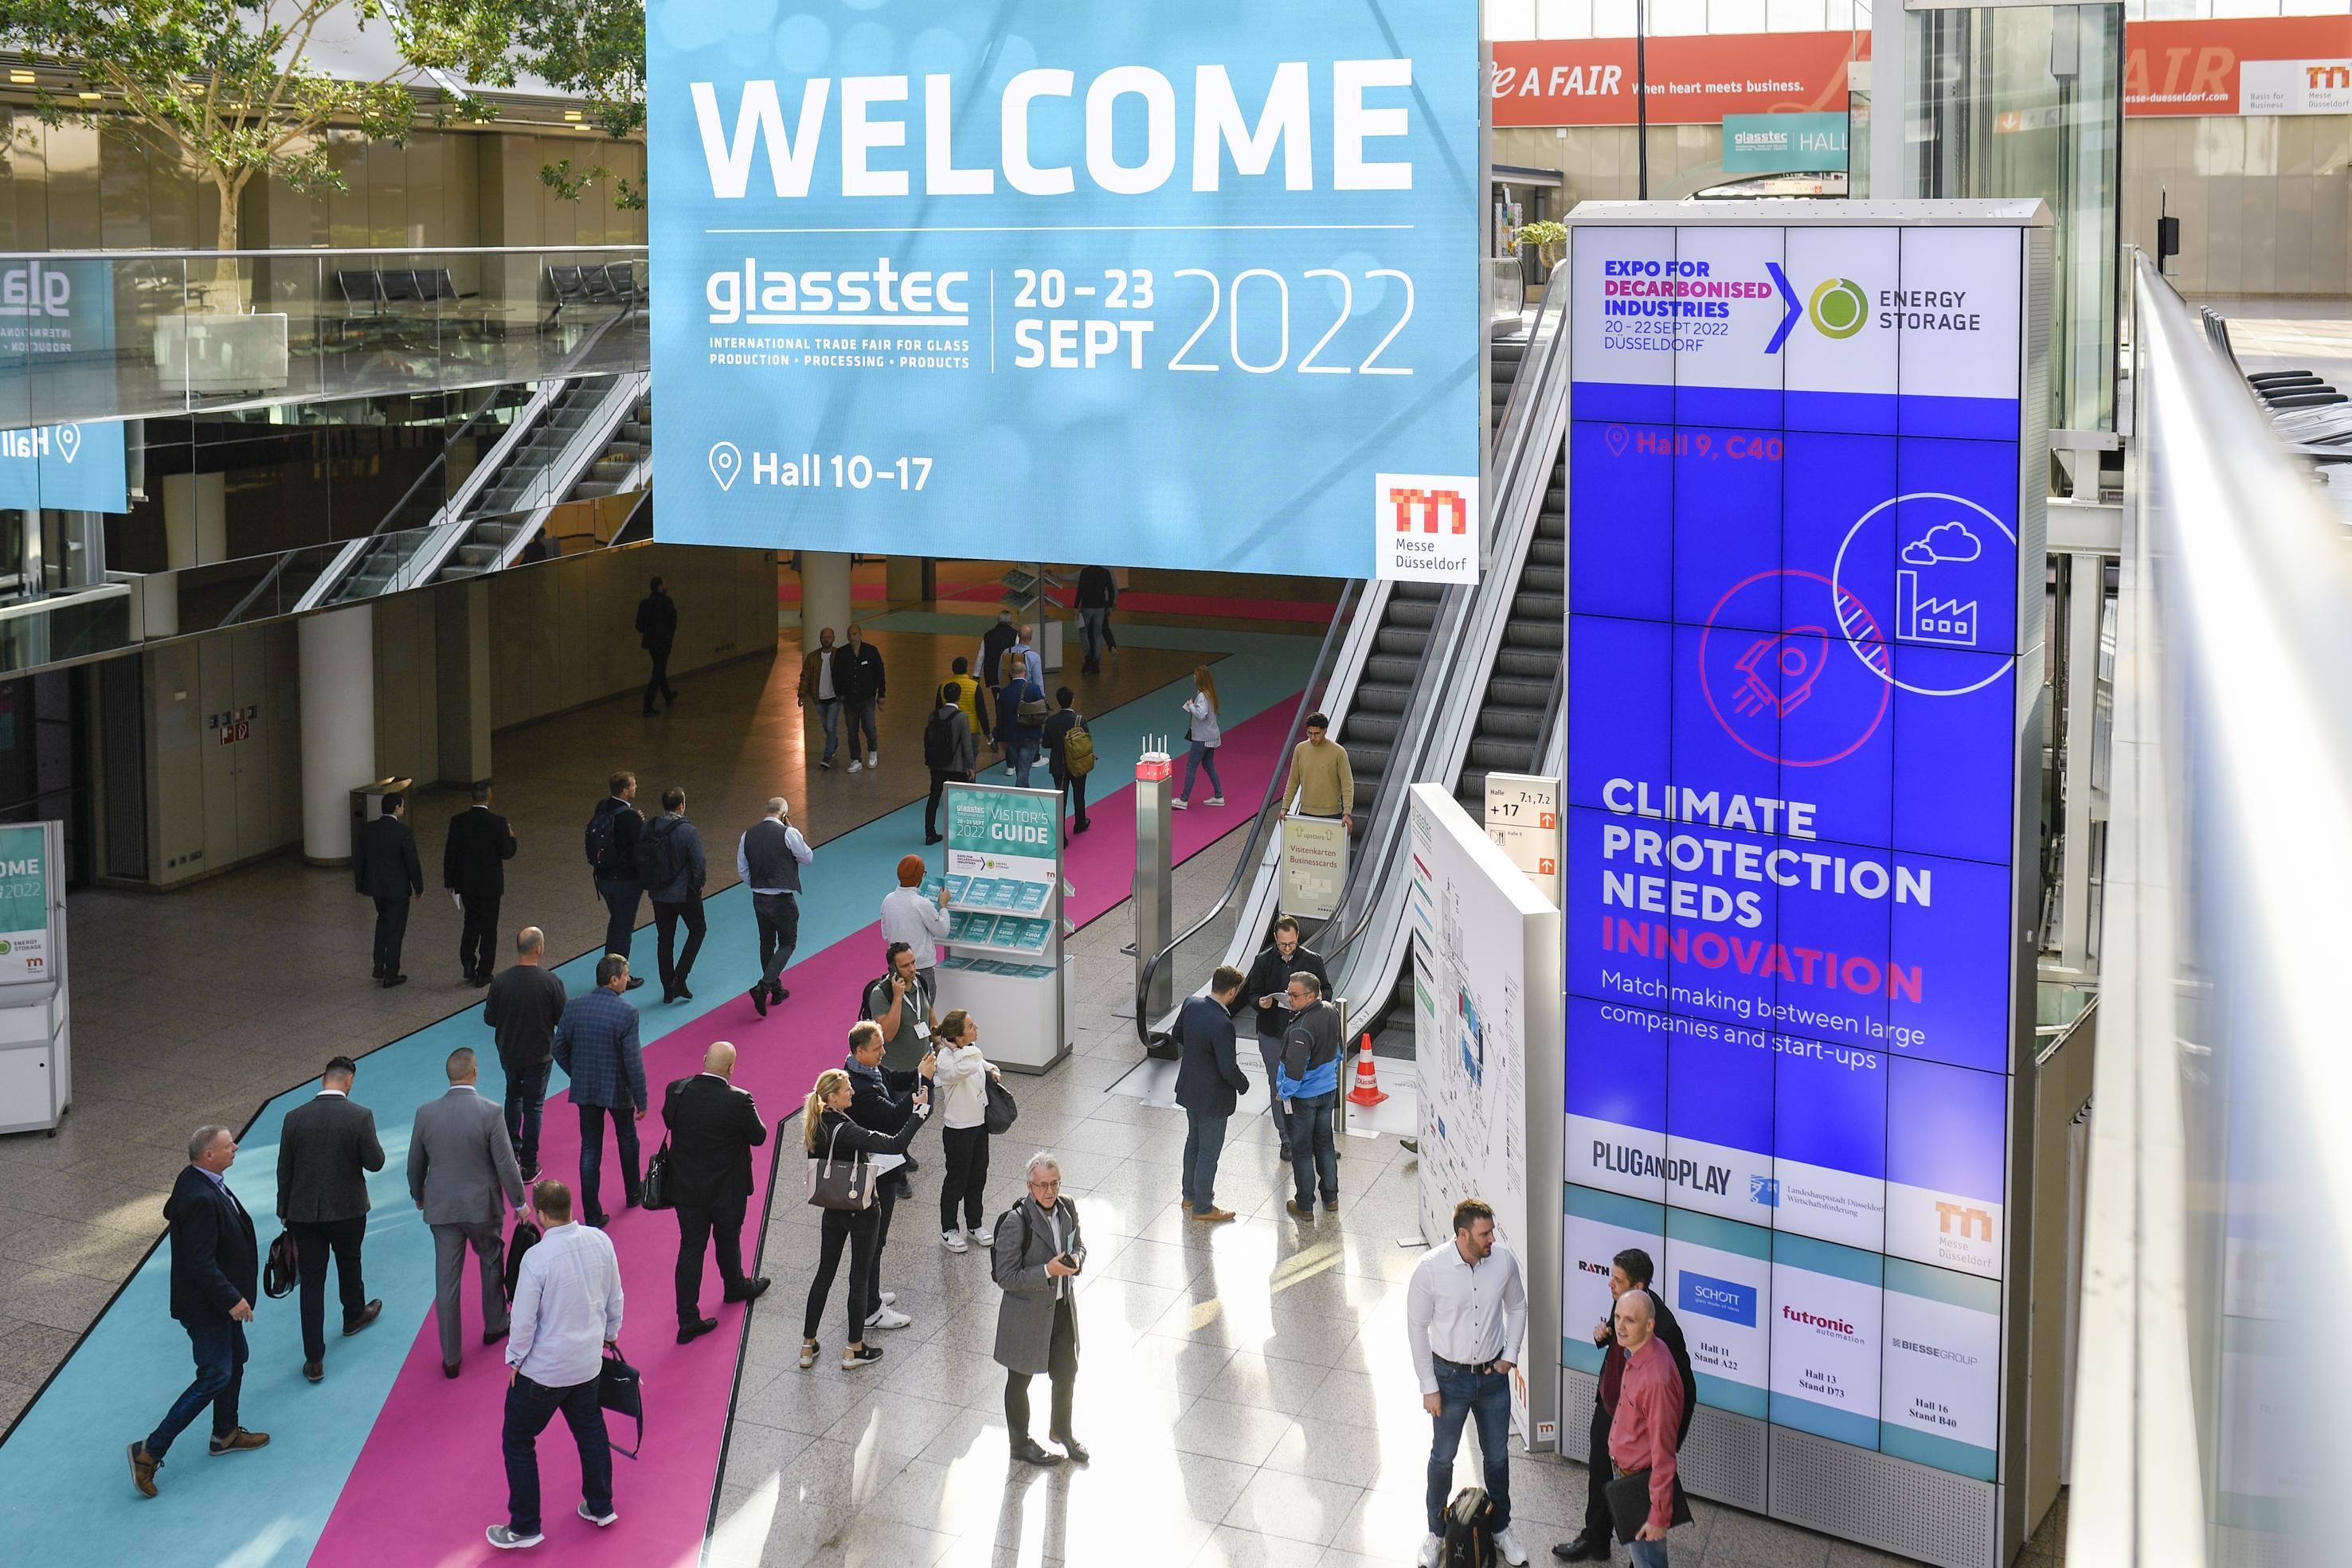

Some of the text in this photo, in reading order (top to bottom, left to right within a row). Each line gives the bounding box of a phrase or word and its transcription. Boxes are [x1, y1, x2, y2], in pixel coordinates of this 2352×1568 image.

[1518, 67, 1540, 97] A
[1548, 65, 1622, 96] FAIR
[1669, 81, 1701, 95] heart
[1705, 82, 1743, 94] meets
[1747, 80, 1804, 93] business.
[2126, 92, 2229, 104] esse-duesseldorf.com
[2308, 100, 2350, 108] Düsseldorf
[690, 58, 1413, 199] WELCOME
[1735, 131, 1788, 145] glasstec
[1605, 260, 1710, 278] EXPO FOR
[706, 257, 969, 325] glasstec
[1604, 280, 1773, 299] DECARBONISED
[1880, 290, 1967, 308] ENERGY
[1604, 299, 1730, 319] INDUSTRIES
[1168, 268, 1415, 375] 2022
[1653, 322, 1692, 334] SEPT
[1693, 323, 1729, 336] 2022
[1879, 312, 1981, 330] STORAGE
[709, 337, 969, 352] INTERNATIONAL TRADE FAIR FOR GLASS
[1014, 319, 1154, 370] SEPT
[1604, 334, 1704, 351] DÜSSELDORF
[709, 354, 969, 369] PRODUCTION PROCESSING PRODUCTS
[1637, 432, 1784, 461] Hall 9, C40
[753, 452, 821, 487] Hall
[1395, 538, 1435, 552] Messe
[1395, 554, 1467, 571] Düsseldorf
[957, 804, 985, 814] glasstec
[990, 807, 1049, 825] VISITOR'S
[1602, 777, 1818, 842] CLIMATE
[957, 823, 985, 839] 2022
[991, 823, 1048, 845] GUIDE
[1289, 844, 1336, 858] Visitenkarten
[1289, 855, 1338, 868] Businesscards
[1603, 823, 1932, 908] PROTECTION
[5, 882, 41, 899] 2022
[1603, 870, 1763, 929] NEEDS
[1601, 915, 1923, 1004] INNOVATION
[1602, 968, 1926, 1048] Matchmaking between large
[1600, 1004, 1878, 1072] companies and start-ups
[1787, 1185, 1885, 1214] Landeshauptstadt Düsseldorf
[1787, 1194, 1859, 1218] Wirtschaftsförderung
[1939, 1236, 1969, 1252] Messe
[1938, 1248, 1993, 1269] Düsseldorf
[1579, 1260, 1610, 1277] RATH
[1695, 1285, 1740, 1306] SCHOTT
[1783, 1305, 1855, 1335] futronic
[1815, 1328, 1865, 1345] automation
[1700, 1342, 1730, 1357] Hall 11
[1901, 1339, 1978, 1367] BIESSEGROUP
[1694, 1351, 1739, 1371] Stand A22
[1805, 1368, 1837, 1385] Hall 13
[1798, 1378, 1845, 1398] Stand D73
[1916, 1398, 1949, 1414] Hall 16
[1908, 1408, 1957, 1428] Stand B40
